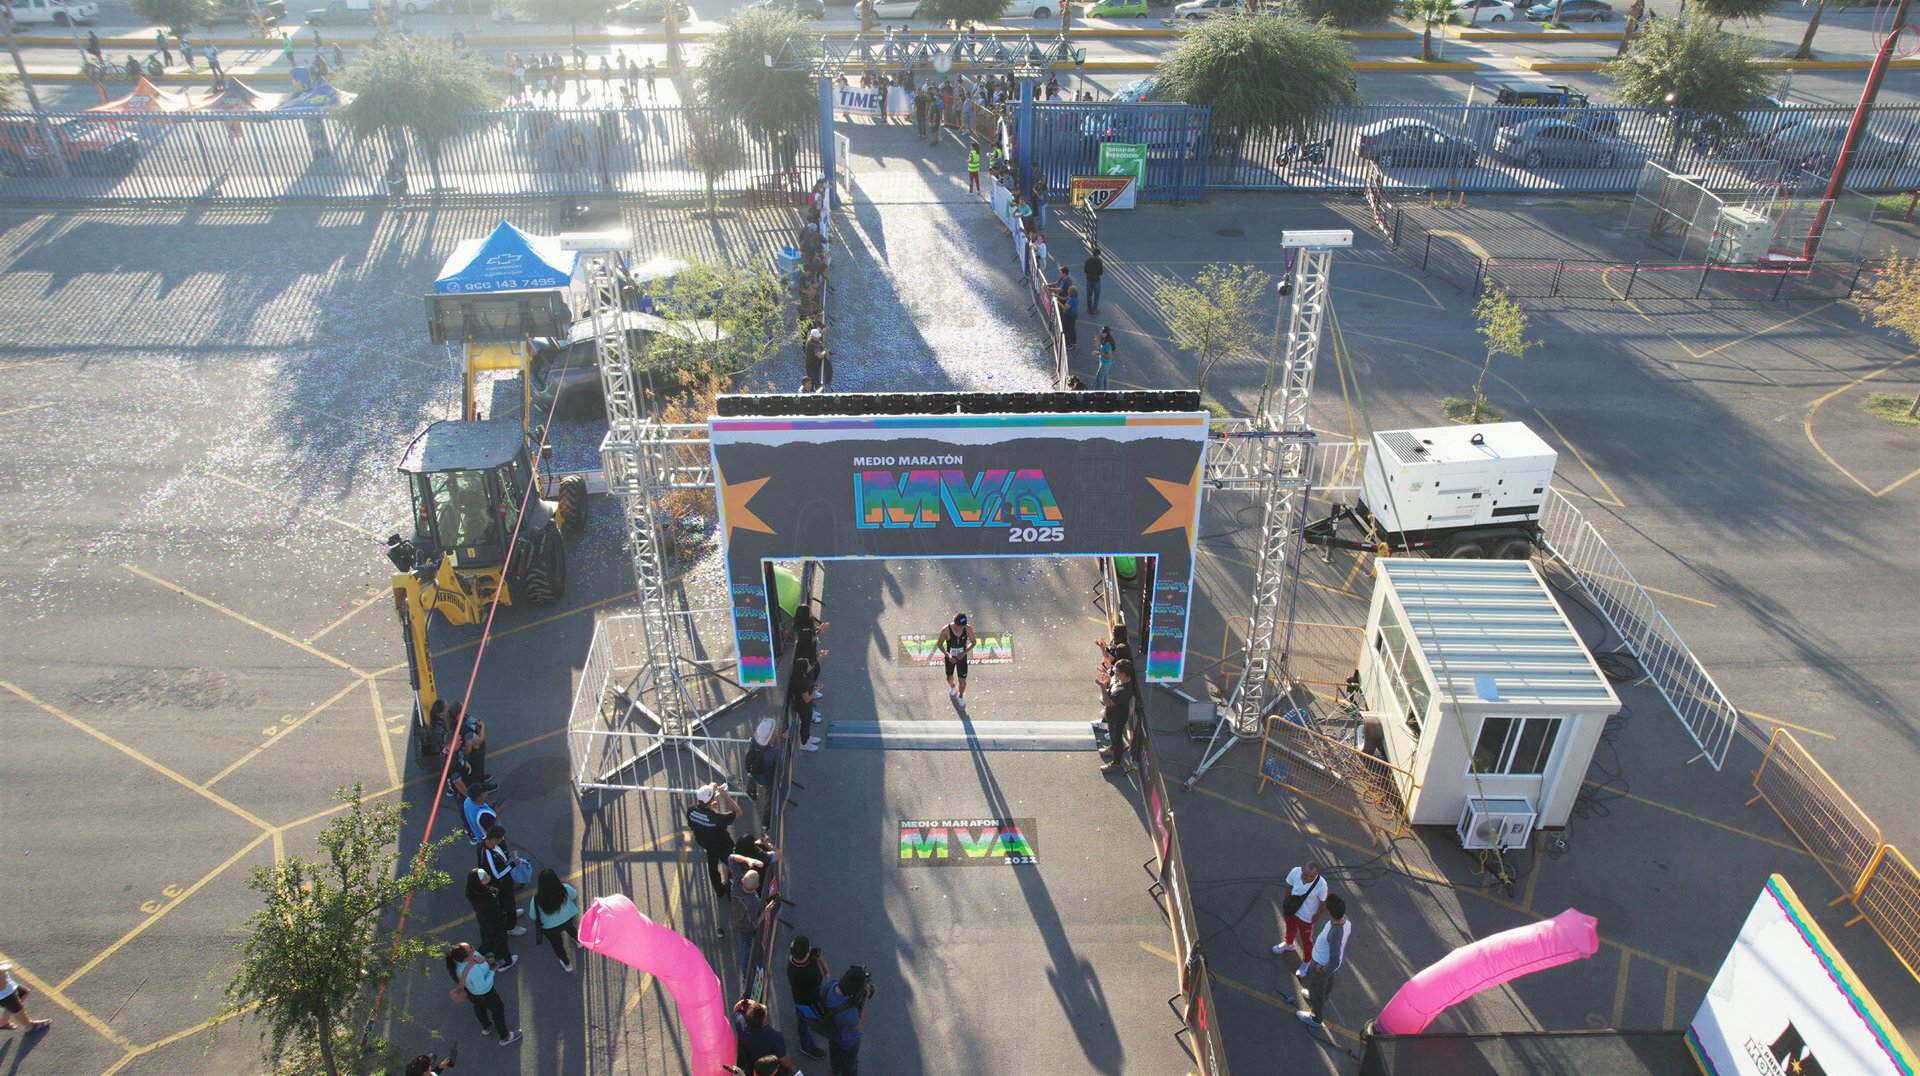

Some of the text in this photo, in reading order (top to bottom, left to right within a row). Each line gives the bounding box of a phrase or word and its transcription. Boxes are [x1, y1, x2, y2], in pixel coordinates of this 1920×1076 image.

[839, 90, 878, 109] TIME
[853, 453, 964, 466] MEDIO MARATÓN
[853, 469, 1064, 529] MVA
[1008, 527, 1065, 542] 2025
[900, 820, 939, 828] MEDIO
[900, 826, 1036, 859] MVA
